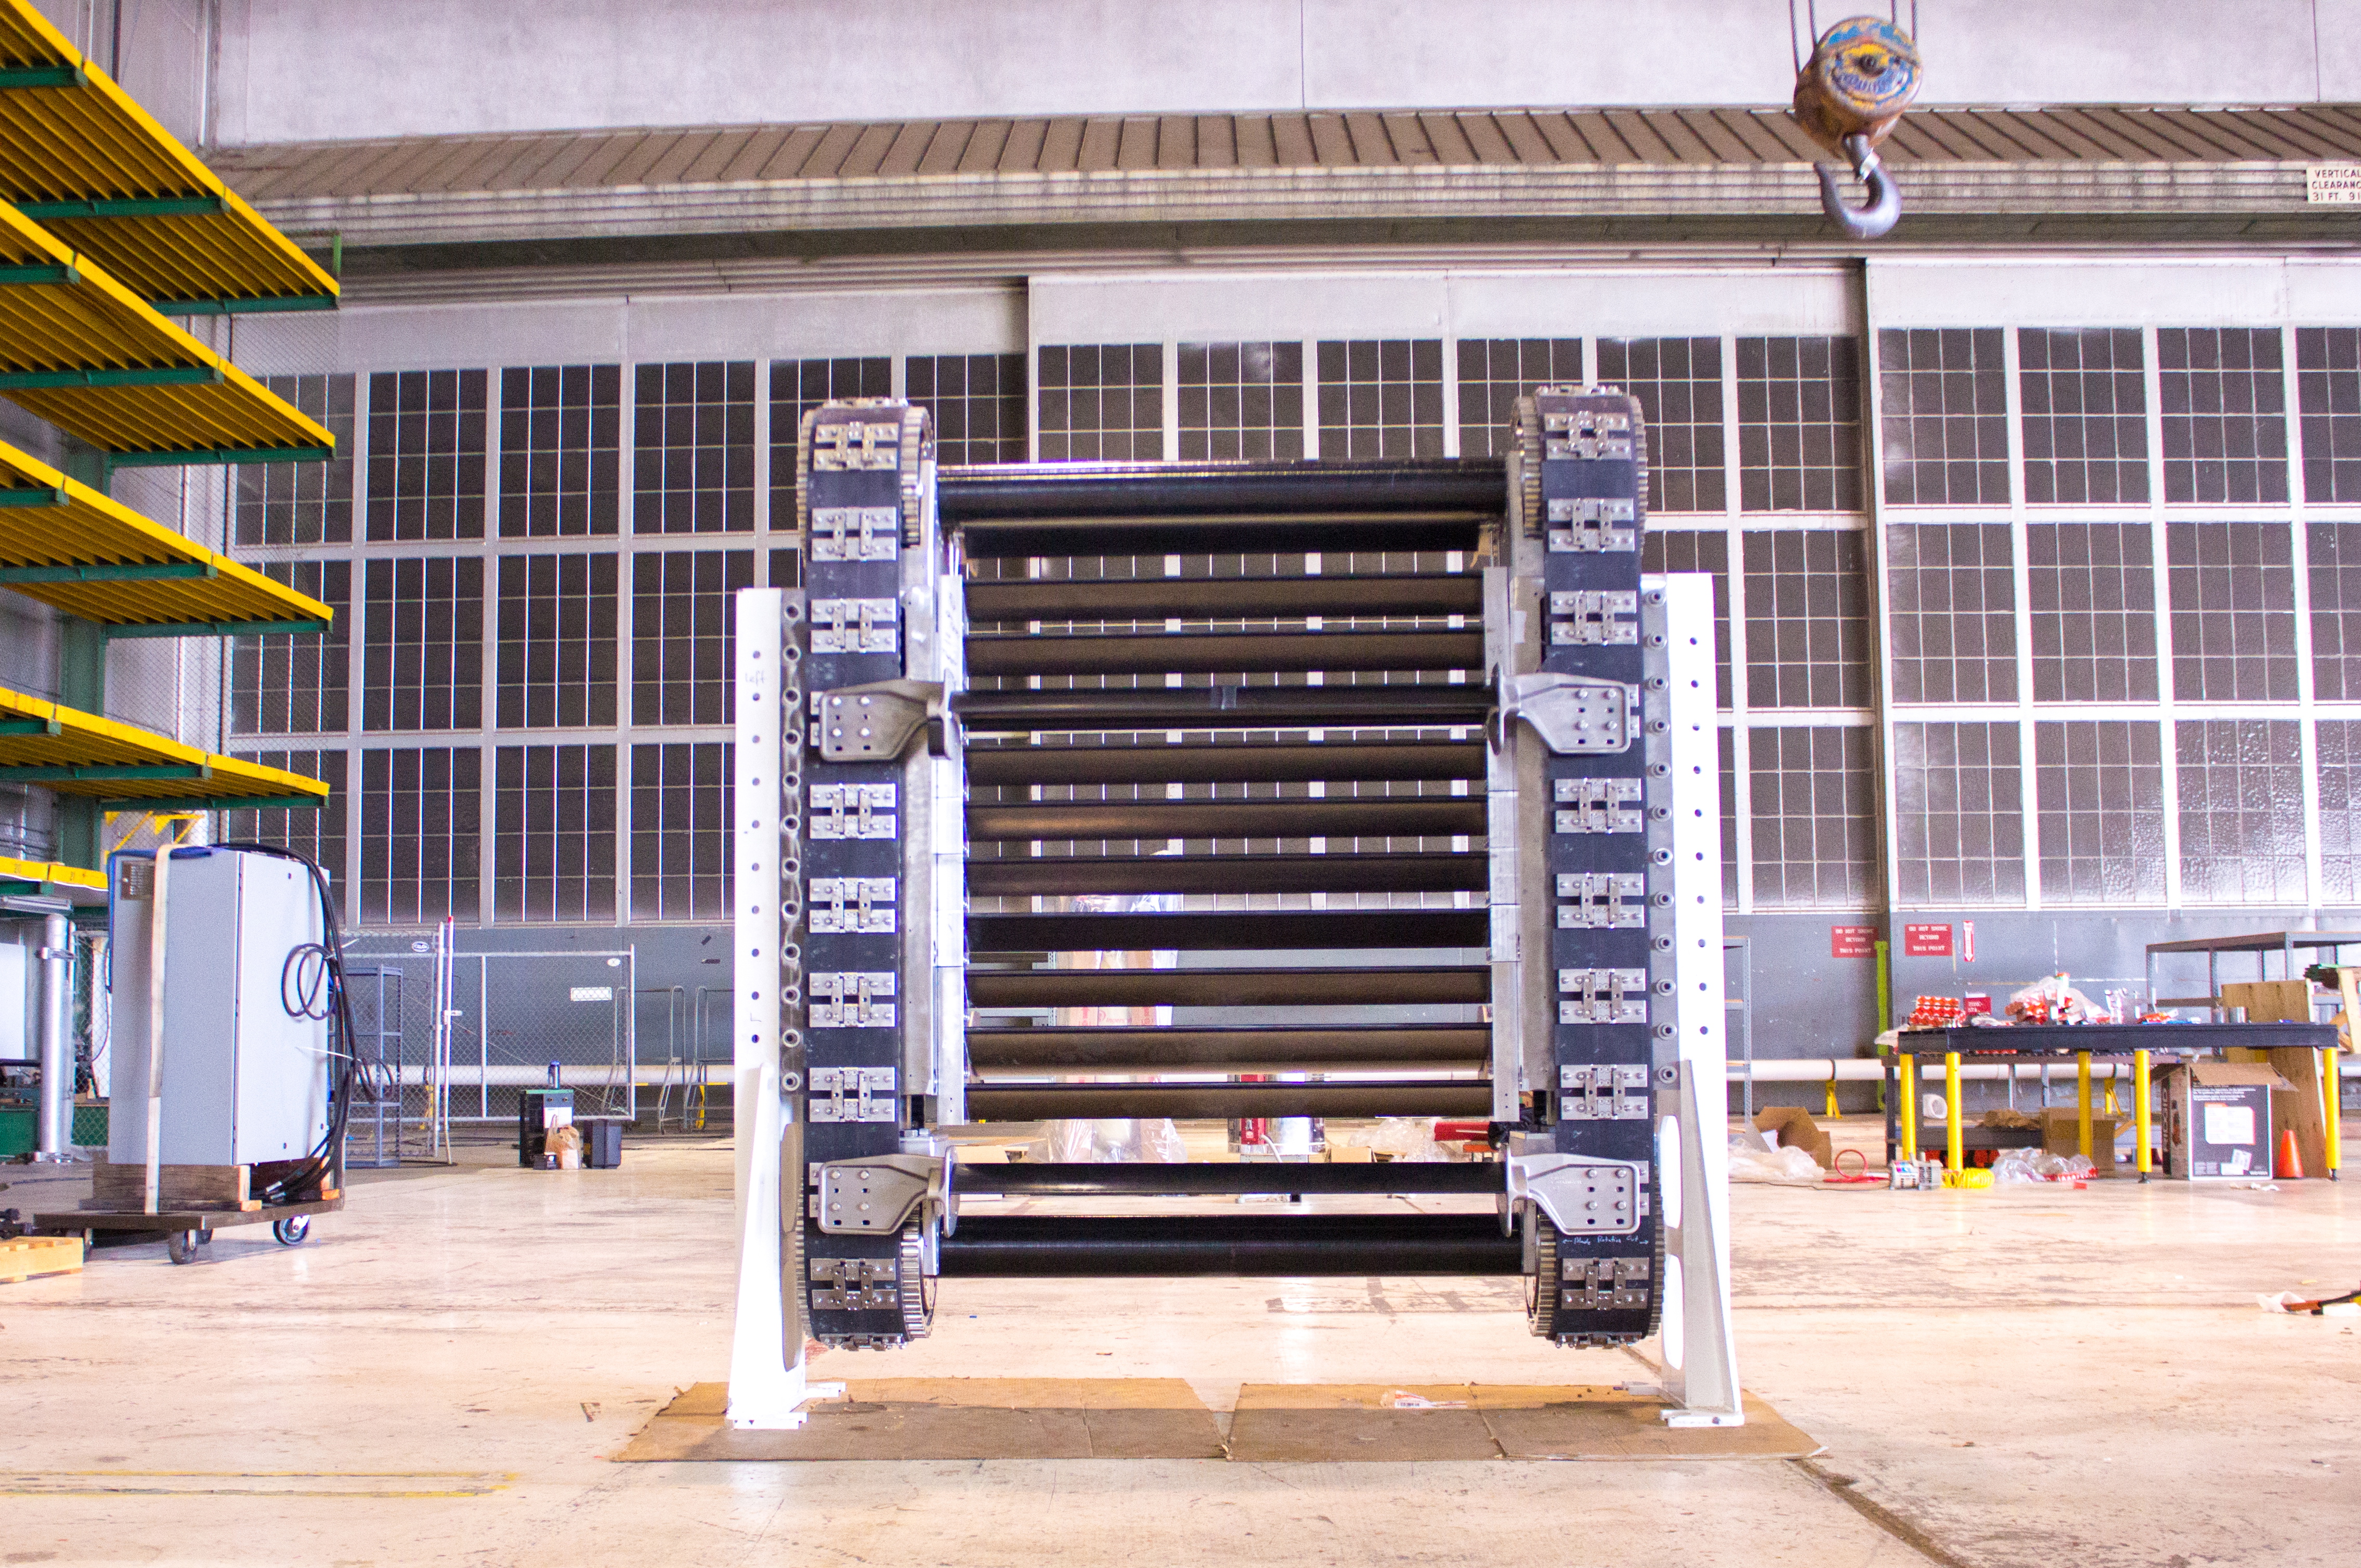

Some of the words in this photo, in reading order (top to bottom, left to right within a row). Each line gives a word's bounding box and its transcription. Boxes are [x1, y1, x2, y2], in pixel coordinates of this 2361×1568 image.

[2314, 169, 2361, 178] VERTICAL
[2313, 191, 2324, 201] 31
[2328, 192, 2342, 201] FT.
